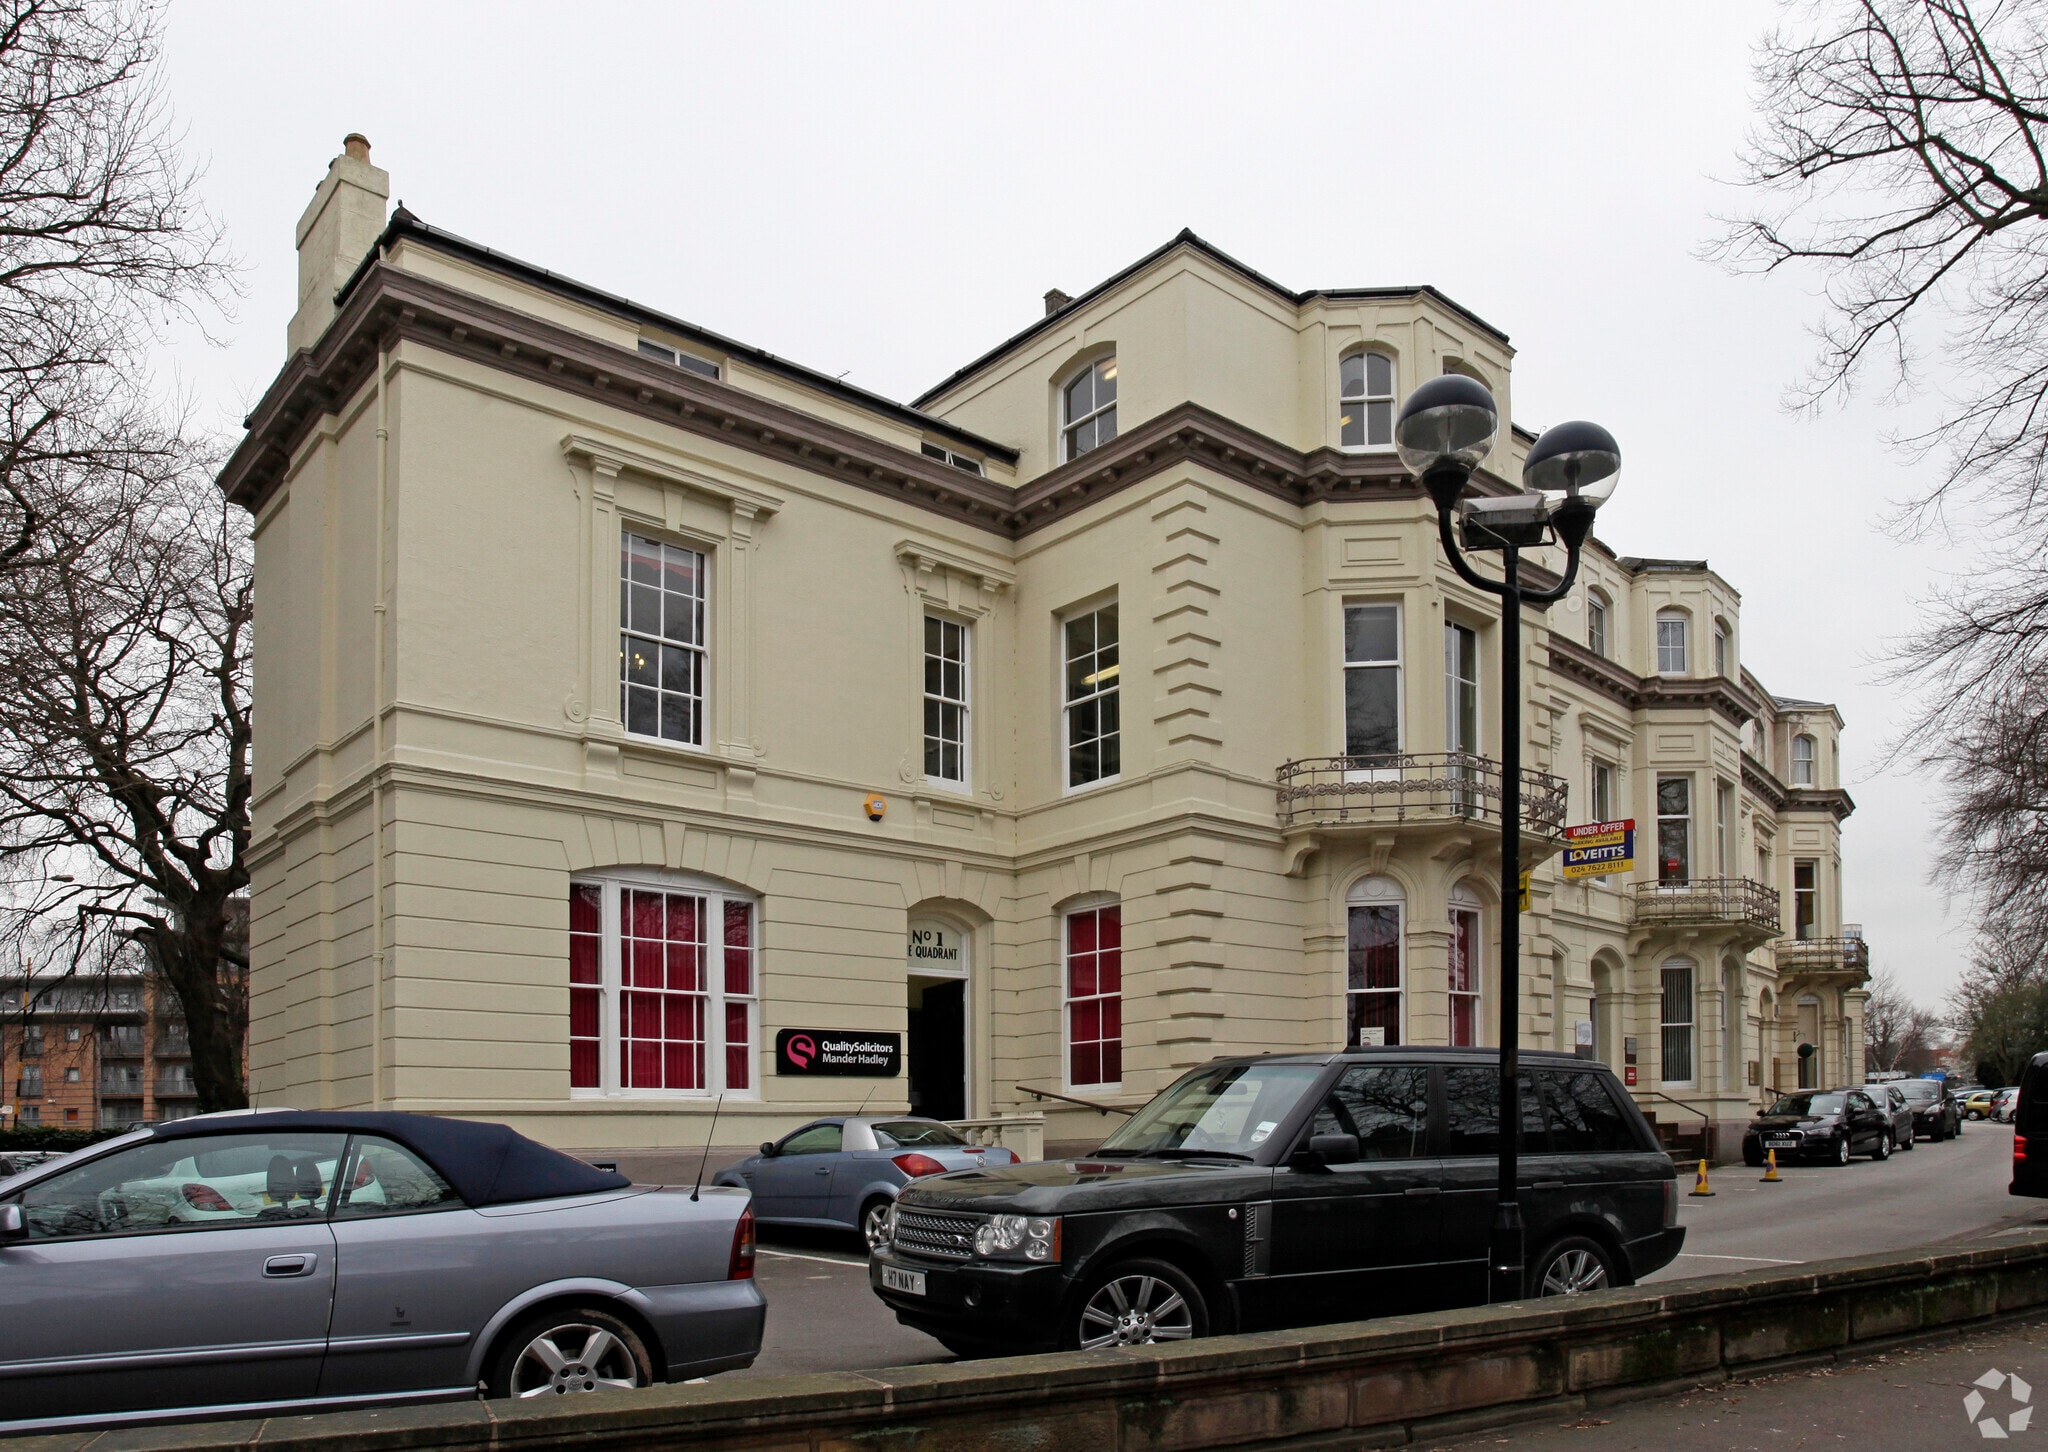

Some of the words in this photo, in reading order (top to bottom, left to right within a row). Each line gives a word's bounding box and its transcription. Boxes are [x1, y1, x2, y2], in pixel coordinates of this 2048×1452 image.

[1573, 825, 1598, 837] UNDER
[1600, 821, 1625, 833] OFFER
[1595, 835, 1622, 843] AVAILABLE
[1569, 845, 1625, 862] LOVEITTS
[1588, 863, 1606, 871] 7622
[1607, 861, 1624, 869] 8111
[936, 932, 943, 946] 1
[915, 945, 958, 960] QUADRANT
[822, 1041, 893, 1054] QualitySolicitors
[822, 1053, 857, 1064] Mander
[858, 1054, 888, 1067] Hadley
[887, 1269, 897, 1287] H7
[898, 1271, 915, 1291] NAY
